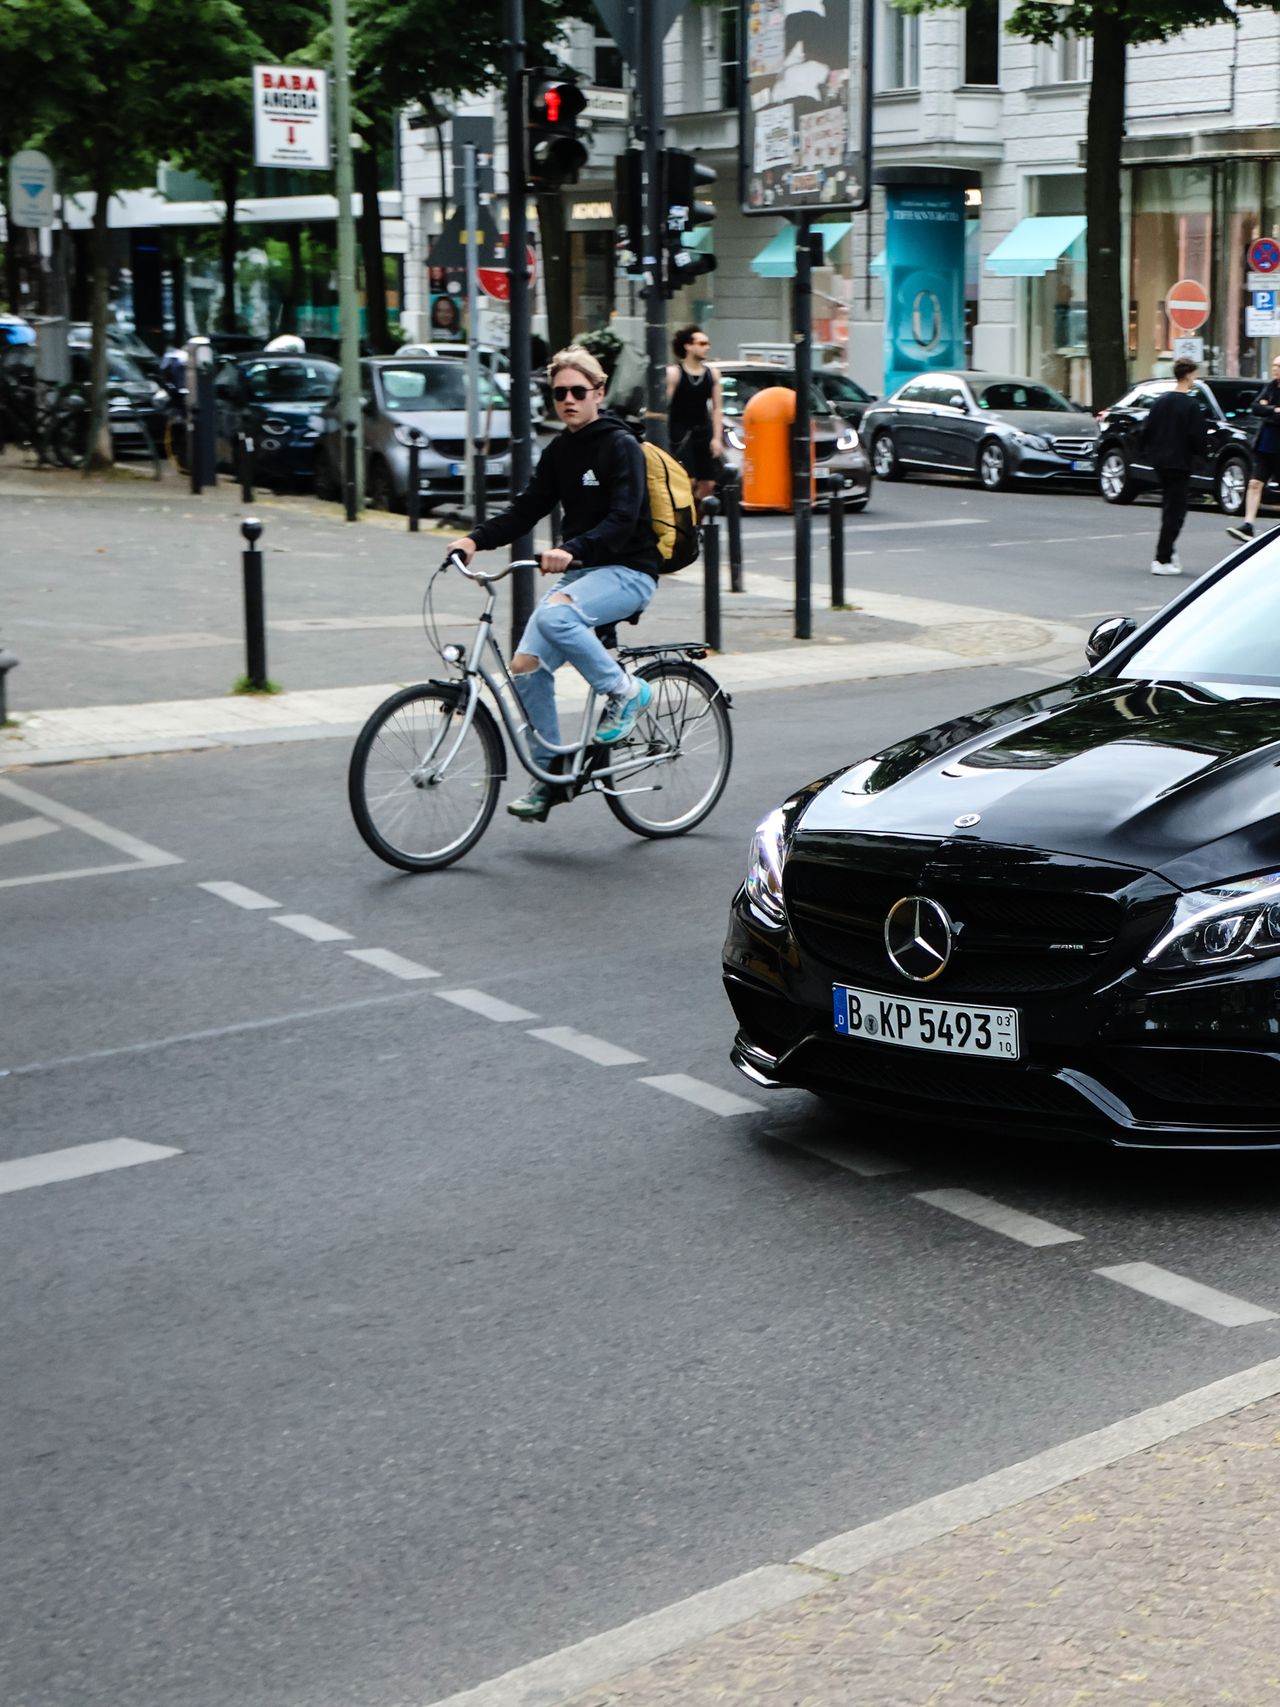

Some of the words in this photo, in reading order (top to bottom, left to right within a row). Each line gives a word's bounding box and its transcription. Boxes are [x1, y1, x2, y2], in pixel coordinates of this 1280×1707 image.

[262, 73, 318, 92] BABA
[262, 91, 318, 110] ANGORA
[847, 993, 863, 1031] B
[879, 1000, 912, 1040] KP
[918, 1007, 992, 1050] 5493
[996, 1015, 1012, 1027] 03
[998, 1041, 1013, 1053] 10
